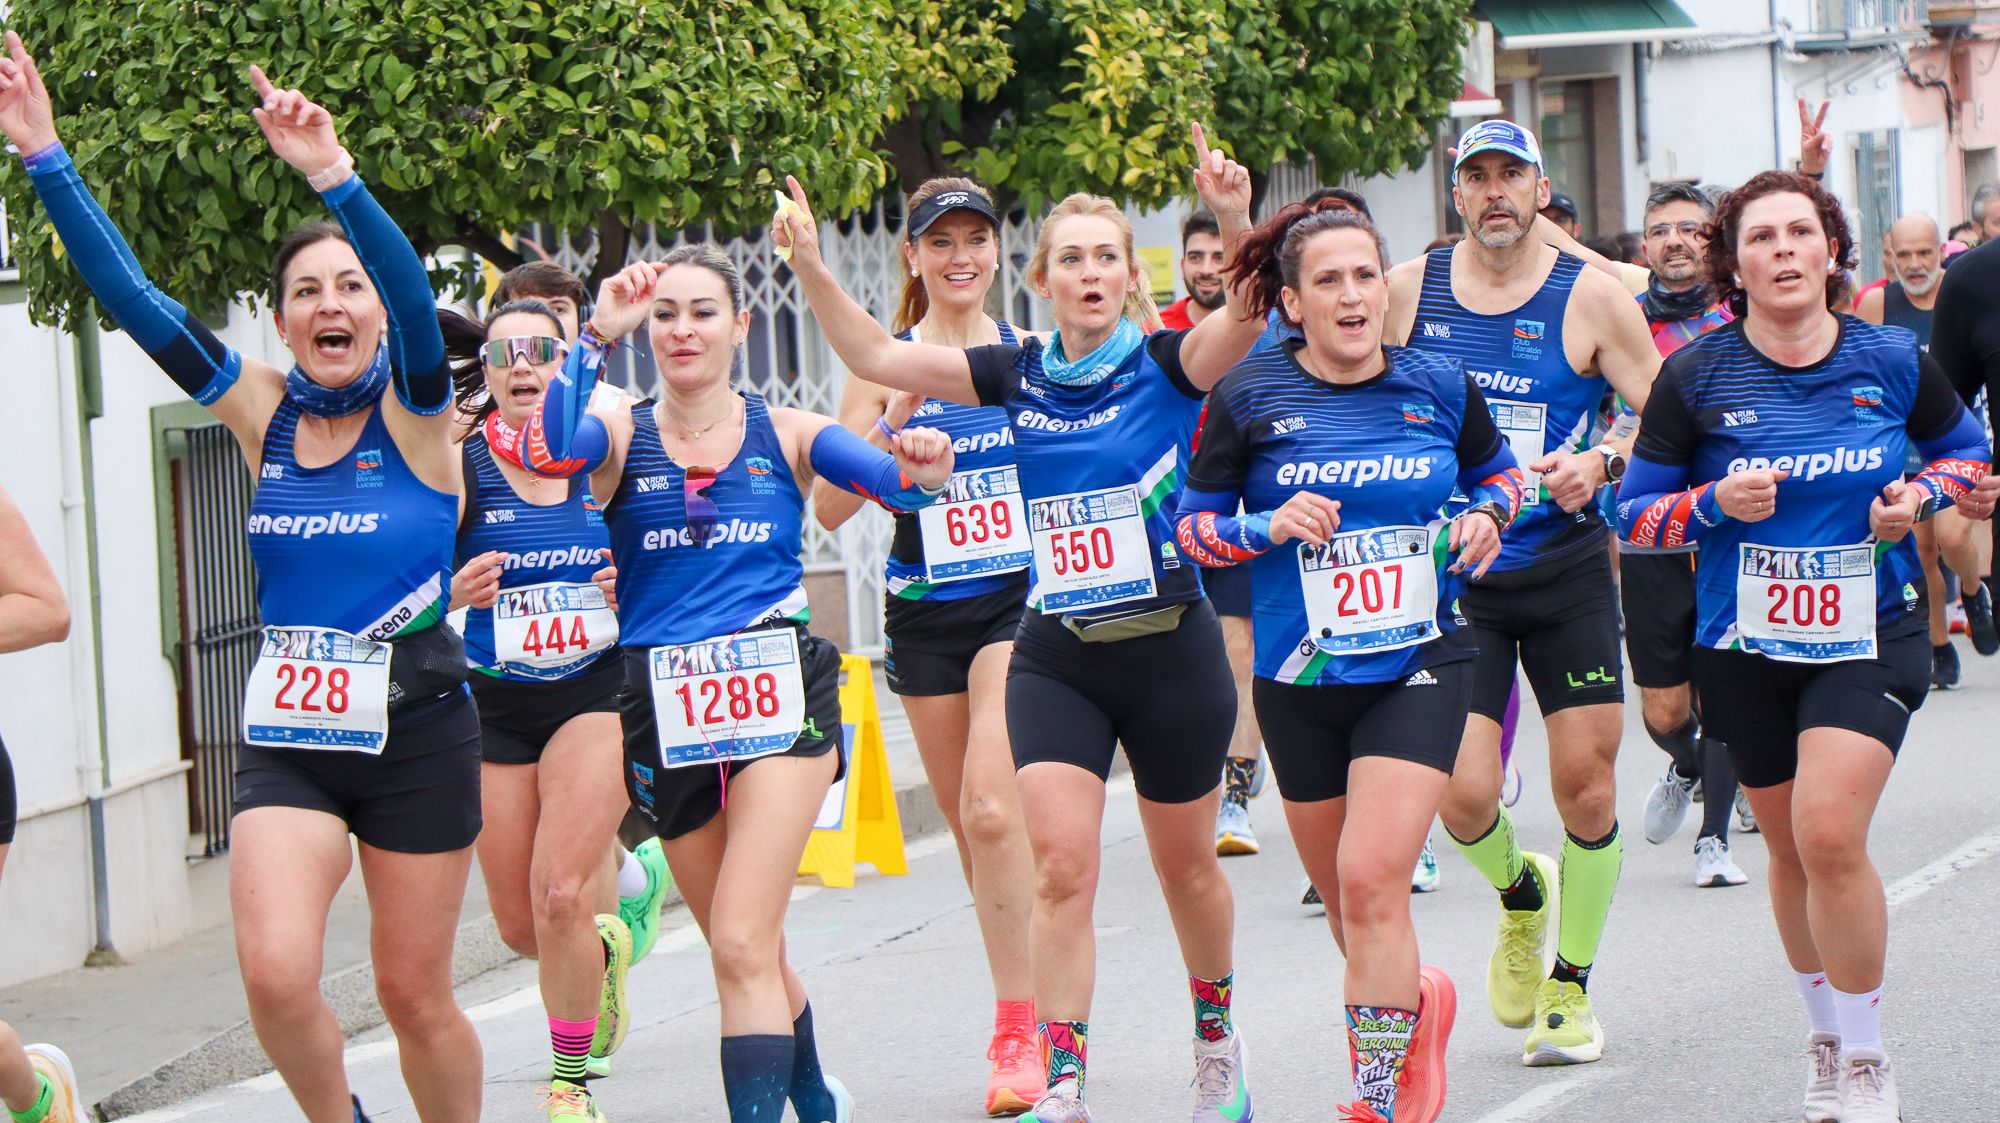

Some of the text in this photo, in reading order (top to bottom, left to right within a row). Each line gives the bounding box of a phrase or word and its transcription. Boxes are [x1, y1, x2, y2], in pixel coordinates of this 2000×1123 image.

[1435, 324, 1449, 332] RUN
[1436, 330, 1451, 339] PRO
[1513, 338, 1530, 346] Club
[1286, 416, 1304, 426] RUN
[1737, 410, 1755, 418] RUN
[1741, 416, 1758, 424] PRO
[1288, 422, 1307, 432] PRO
[650, 476, 668, 484] RUN
[651, 482, 669, 490] PRO
[946, 500, 1012, 546] 639
[1040, 500, 1072, 530] 21K
[500, 546, 601, 570] nerplus
[1050, 527, 1115, 576] 550
[1758, 550, 1800, 579] 21K
[511, 588, 548, 617] 21K
[1333, 564, 1402, 617] 207
[1767, 583, 1841, 627] 208
[523, 616, 589, 656] 444
[670, 644, 717, 677] 21K
[275, 664, 350, 713] 228
[1406, 678, 1437, 686] adidas
[675, 672, 780, 727] 1288
[1358, 1020, 1410, 1033] ERES MI
[1361, 1061, 1394, 1085] THE
[1363, 1084, 1396, 1104] BEST
